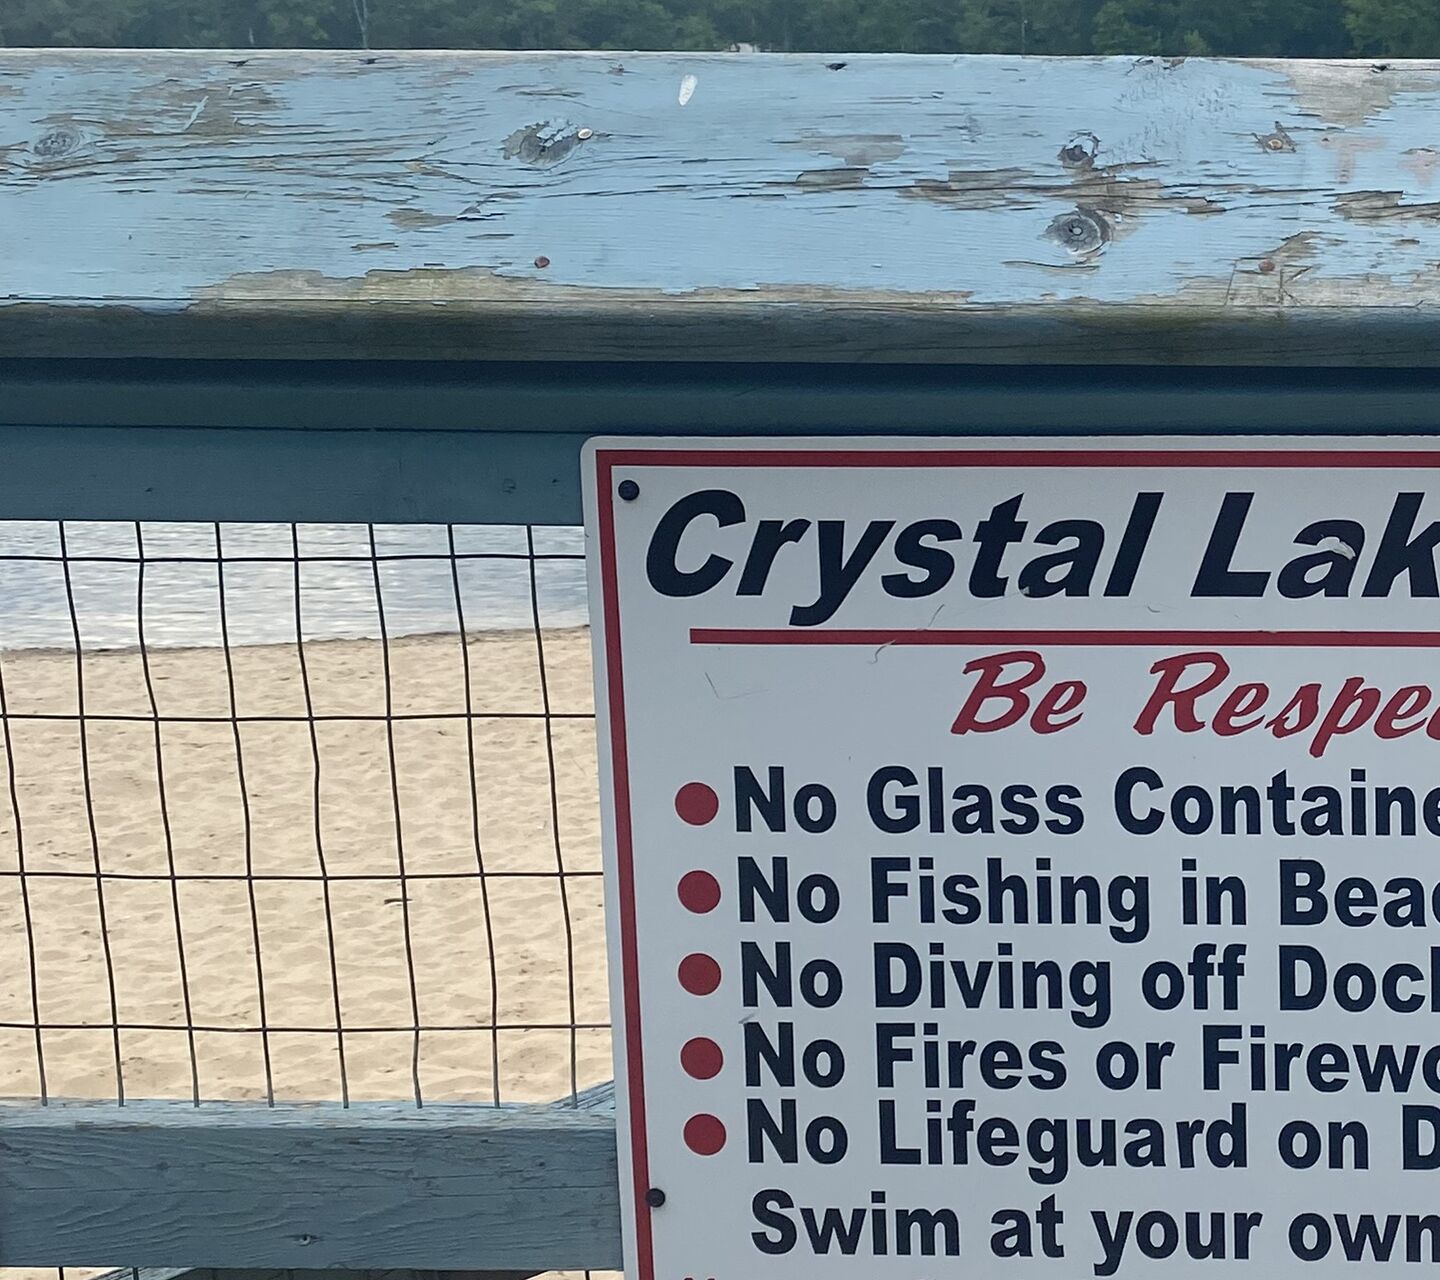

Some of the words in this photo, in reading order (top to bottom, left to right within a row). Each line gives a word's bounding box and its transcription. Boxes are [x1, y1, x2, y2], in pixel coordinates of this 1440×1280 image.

[645, 489, 1165, 627] Crystal
[950, 650, 1088, 736] Be
[733, 765, 837, 834] No
[866, 765, 1085, 835] Glass
[737, 855, 840, 924] No
[870, 856, 1150, 944] Fishing
[1181, 858, 1247, 926] in
[740, 941, 843, 1009] No
[873, 941, 1112, 1029] Diving
[1141, 942, 1248, 1011] off
[742, 1021, 846, 1089] No
[875, 1022, 1067, 1091] Fires
[1095, 1040, 1176, 1091] or
[746, 1098, 849, 1165] No
[878, 1098, 1248, 1185] Lifeguard
[1277, 1120, 1369, 1170] on
[751, 1188, 961, 1257] Swim
[990, 1193, 1065, 1259] at
[1090, 1210, 1264, 1277] your
